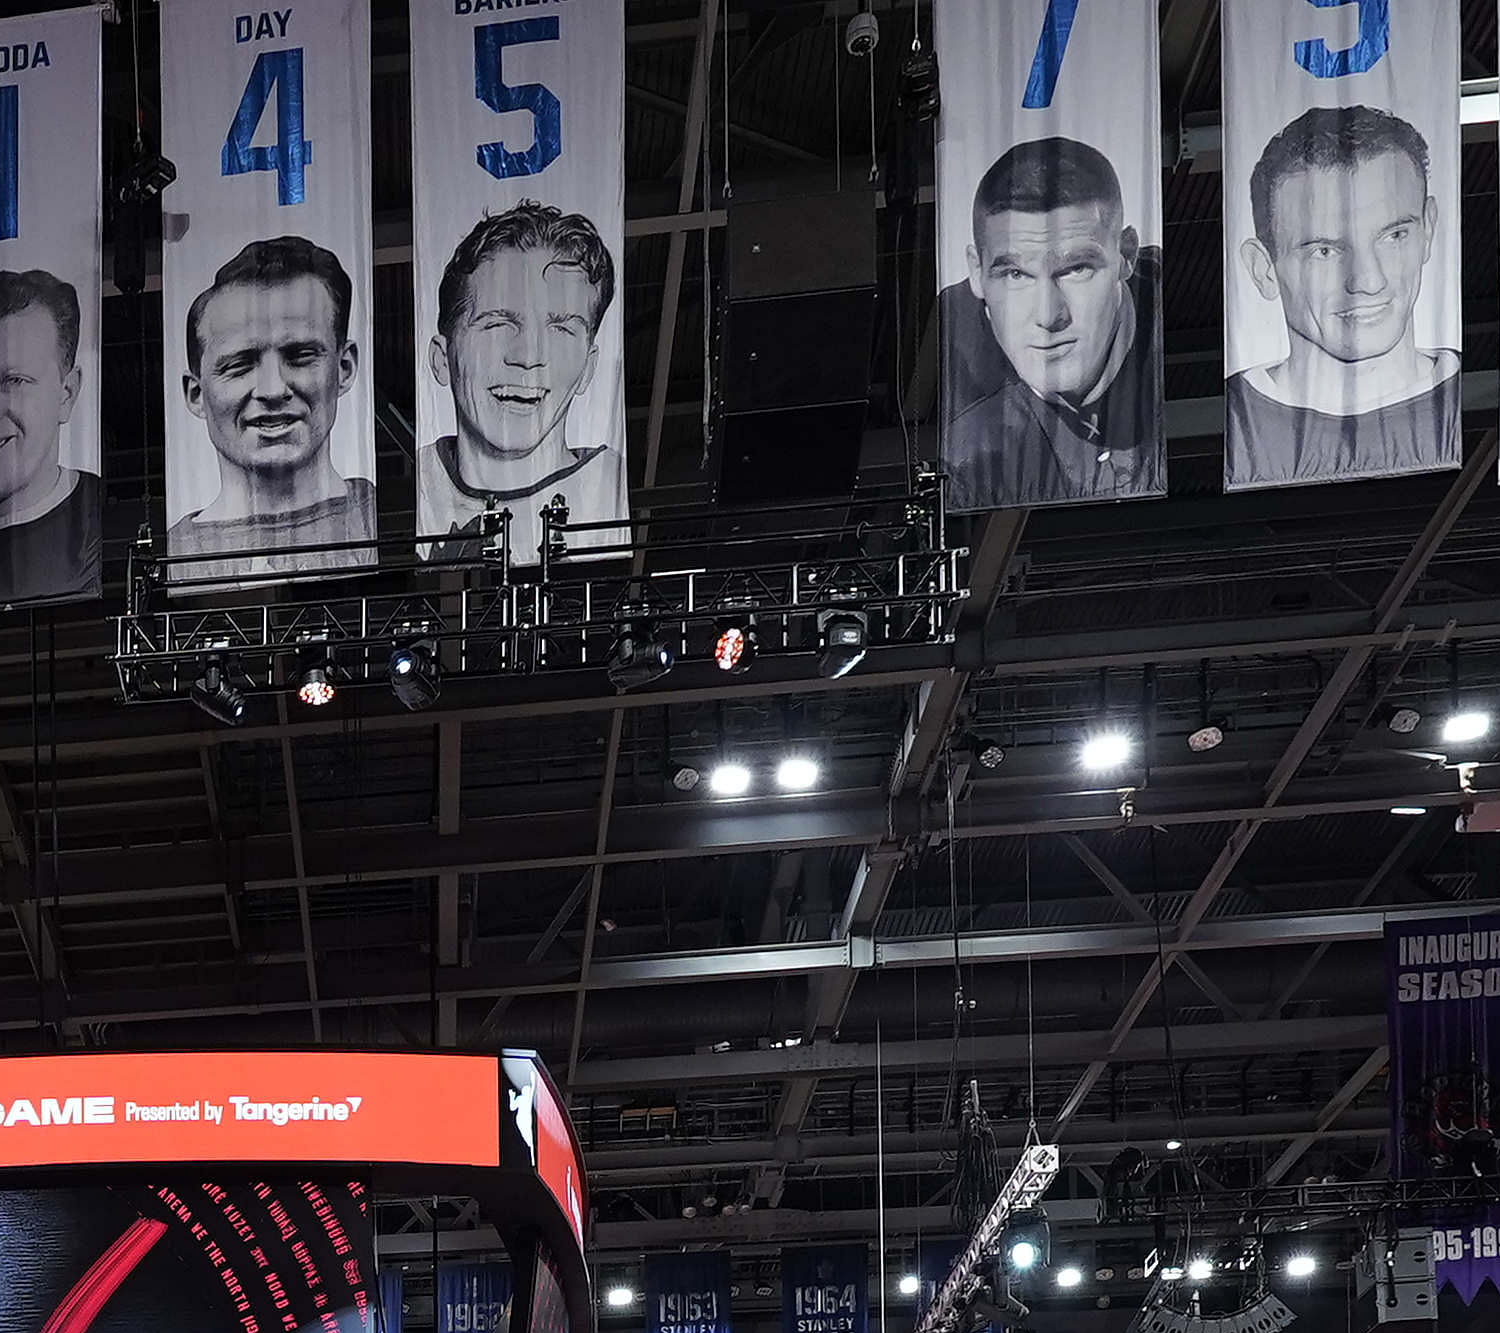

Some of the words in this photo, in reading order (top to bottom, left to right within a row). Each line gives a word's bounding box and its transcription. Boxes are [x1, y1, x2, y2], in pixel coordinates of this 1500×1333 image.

[235, 8, 293, 45] DAY
[474, 15, 561, 181] 5
[221, 47, 312, 206] 4
[125, 1101, 199, 1124] Presented
[203, 1101, 224, 1126] by
[229, 1095, 351, 1126] Tangerine
[795, 1284, 857, 1316] 1964
[797, 1317, 855, 1333] STANLEY
